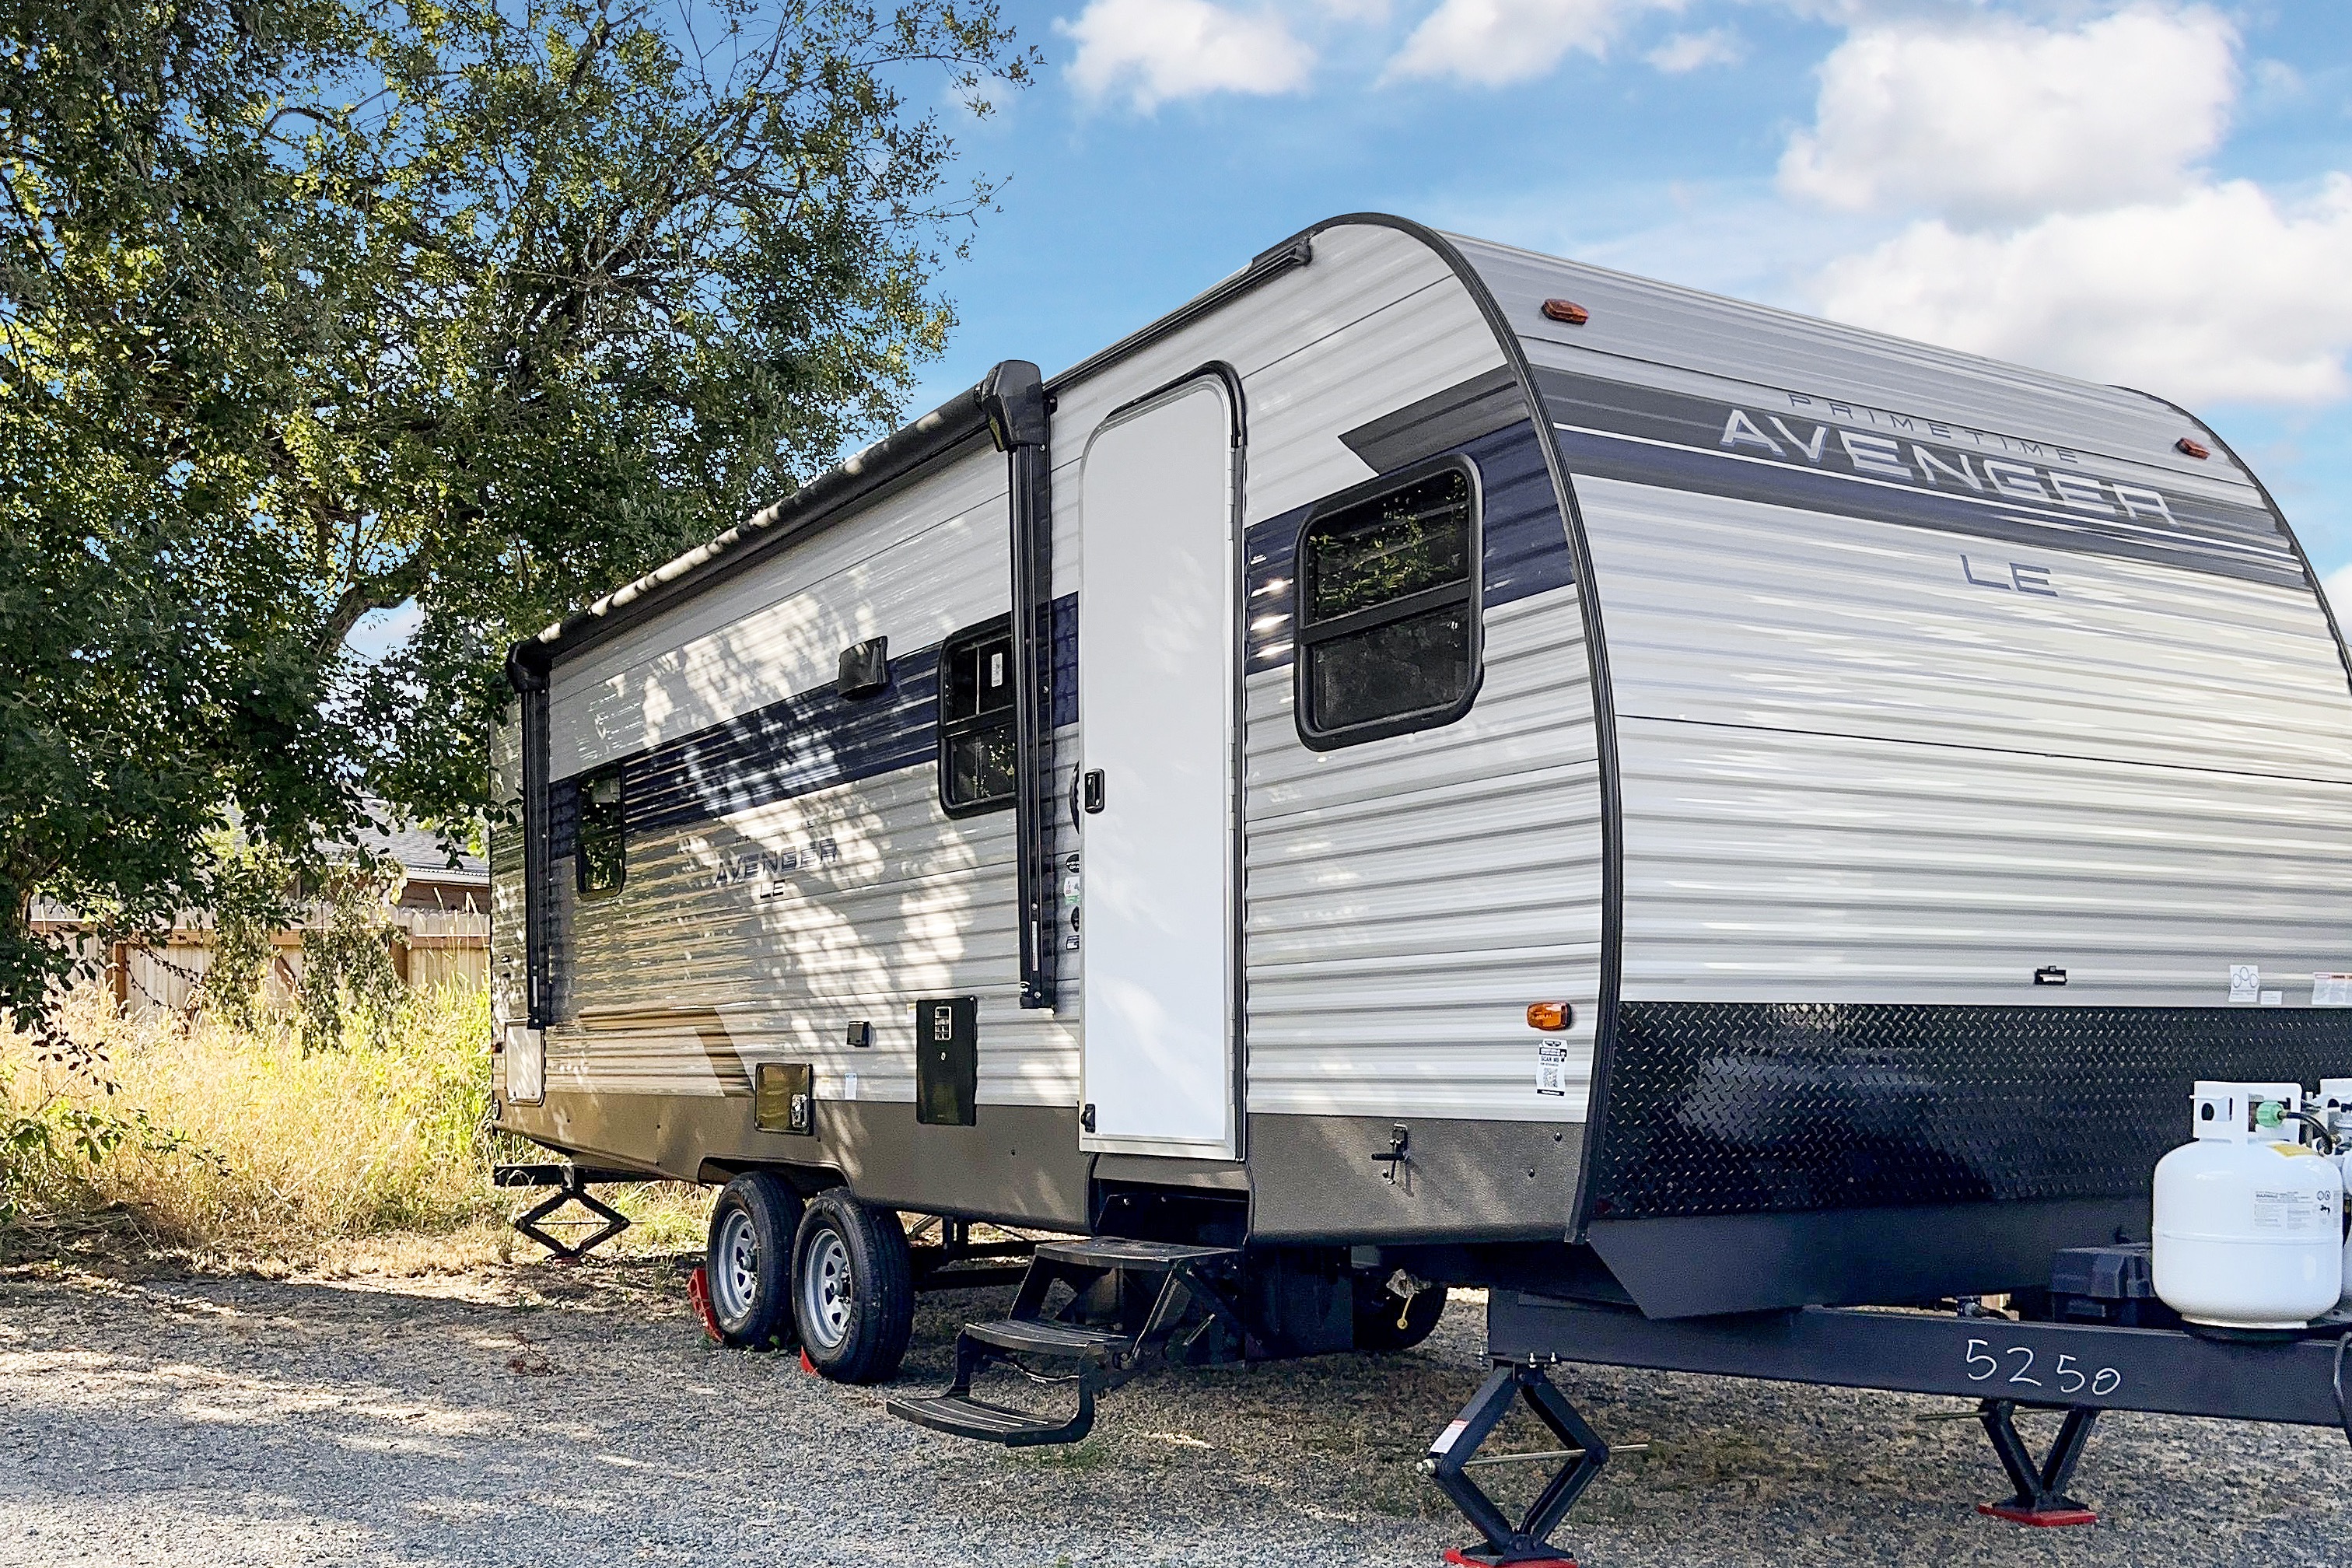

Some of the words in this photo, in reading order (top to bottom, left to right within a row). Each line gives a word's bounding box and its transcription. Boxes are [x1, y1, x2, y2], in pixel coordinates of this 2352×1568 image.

[1720, 408, 2179, 526] AVENGER
[1960, 554, 2058, 597] LE
[714, 837, 838, 887] AVENGER
[759, 879, 785, 899] LE
[1966, 1339, 2121, 1395] 5250
